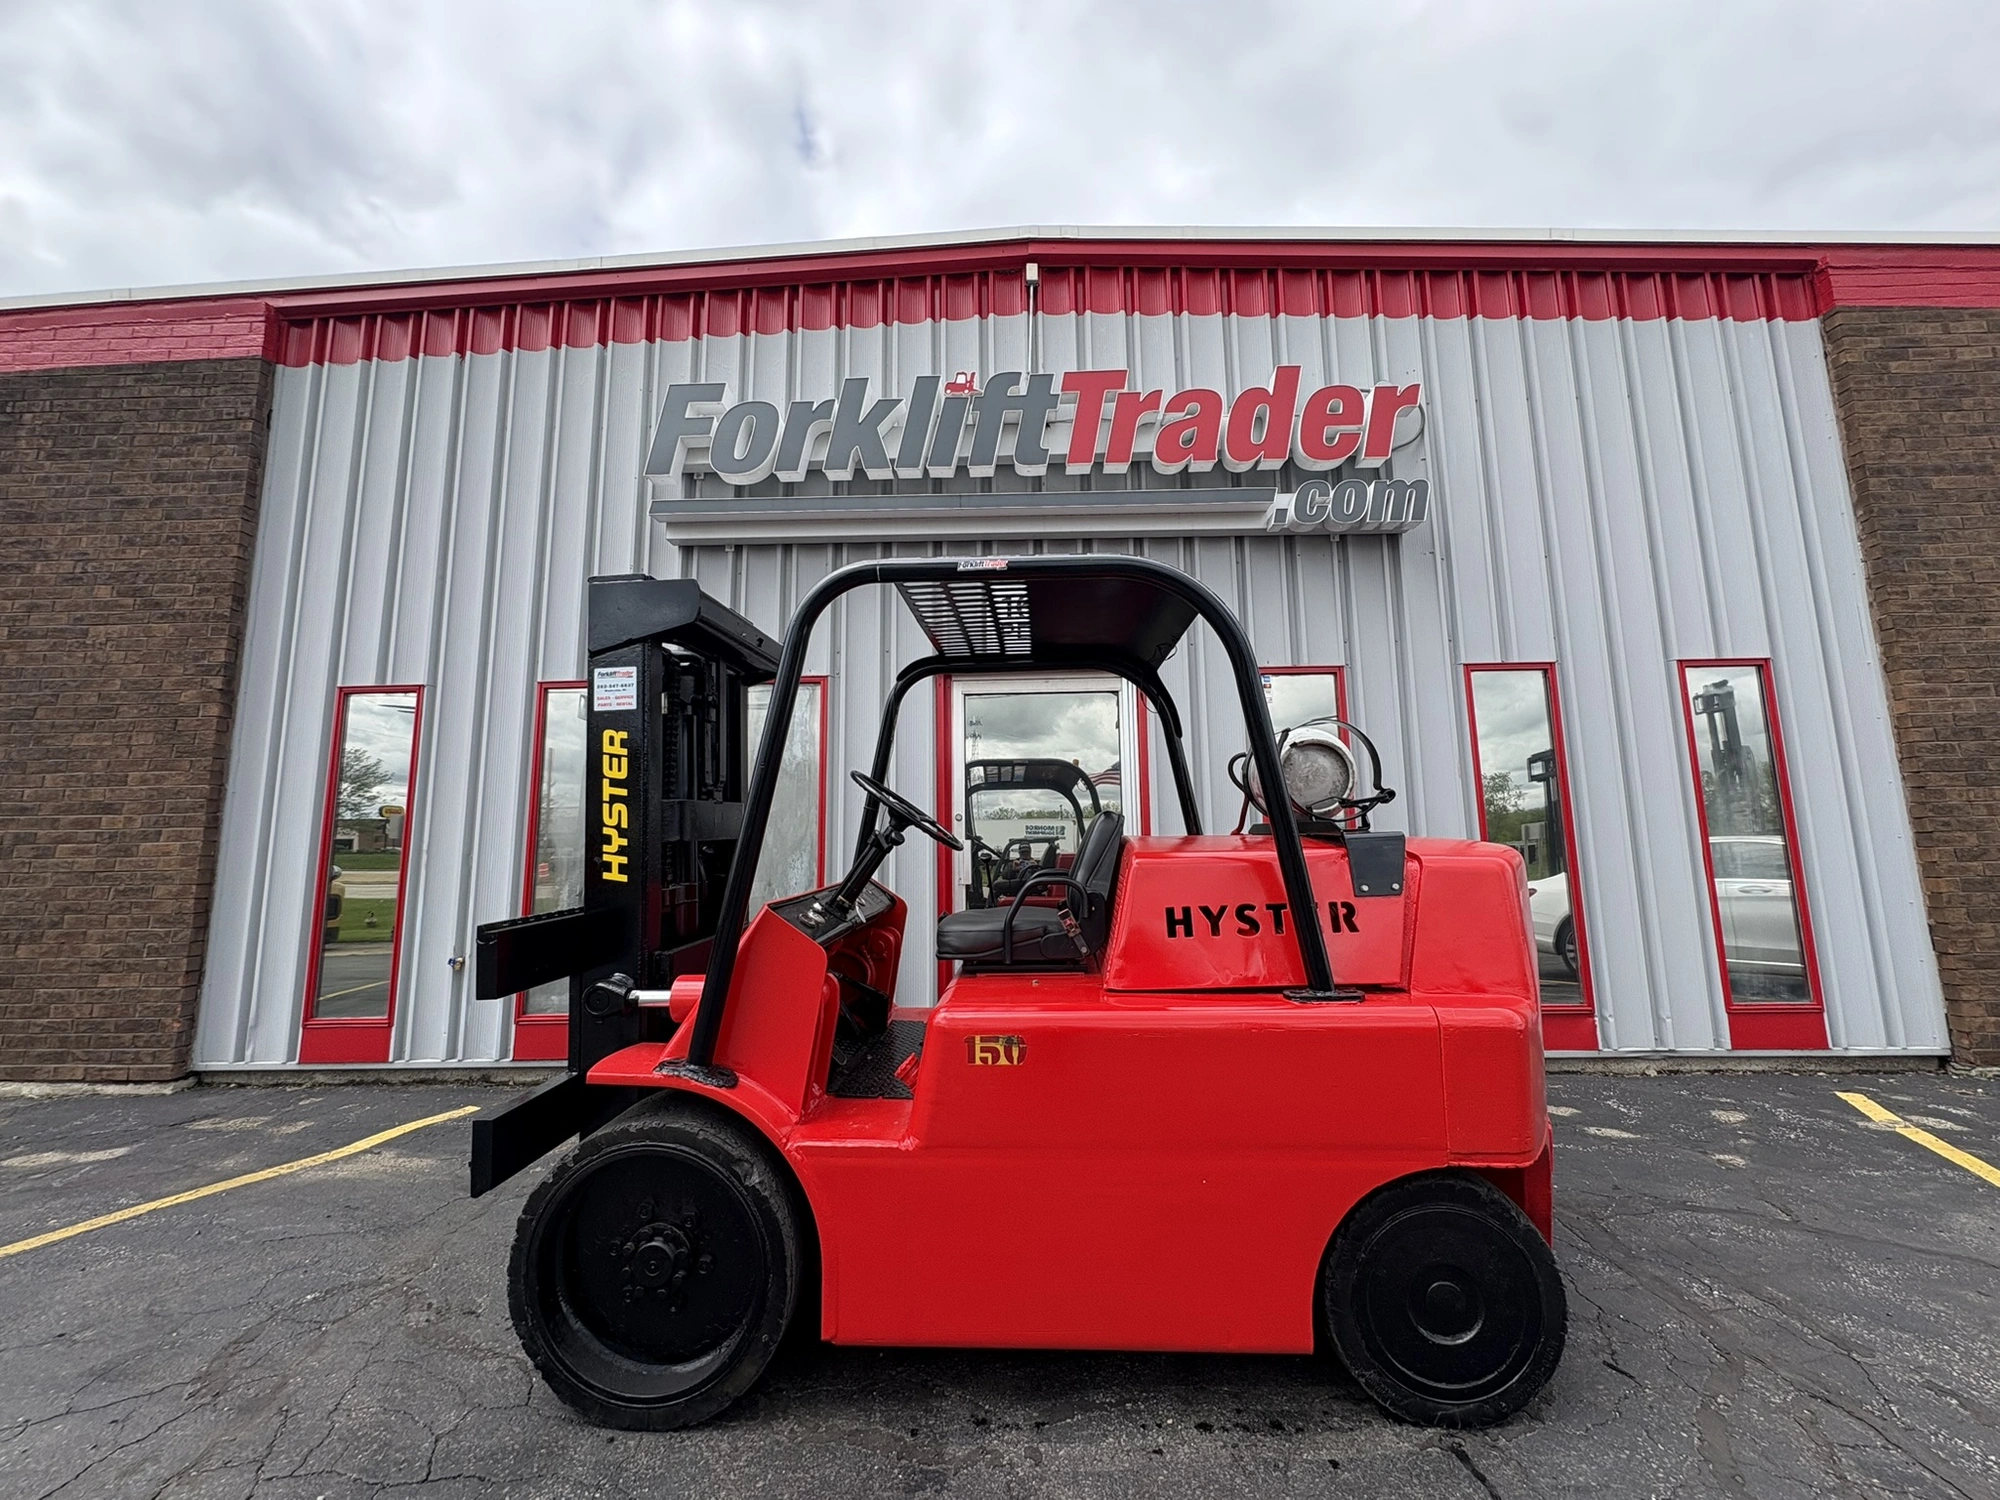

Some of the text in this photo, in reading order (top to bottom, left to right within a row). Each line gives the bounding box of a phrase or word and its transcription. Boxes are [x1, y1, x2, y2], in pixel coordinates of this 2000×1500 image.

[643, 364, 1423, 482] ForkliftTrader
[1272, 477, 1430, 528] .com
[602, 728, 628, 882] HYSTER
[1165, 901, 1360, 938] HYSTR
